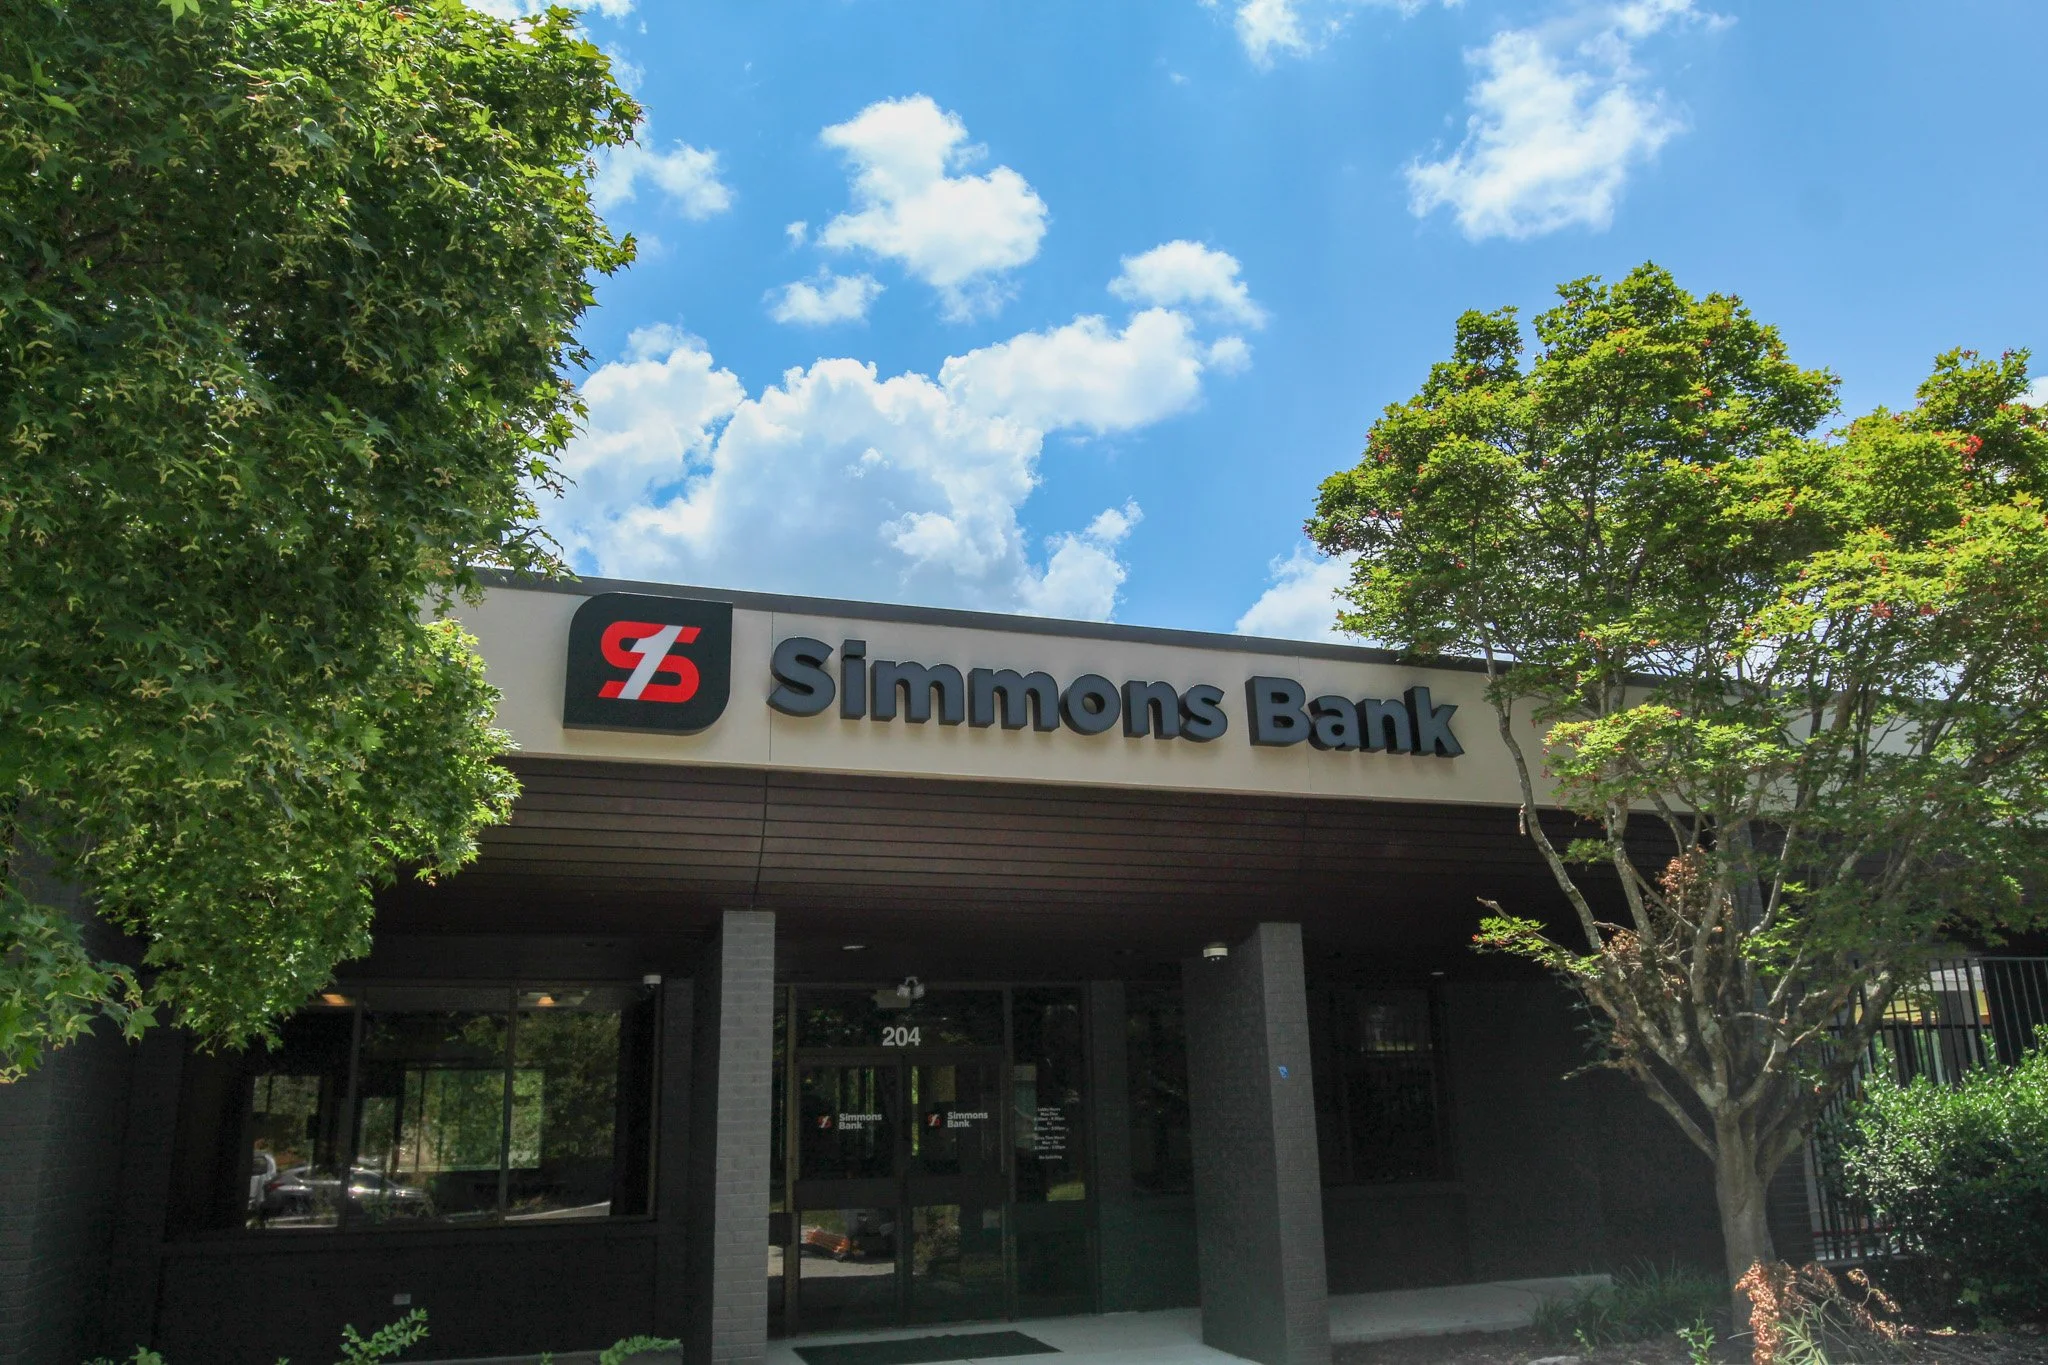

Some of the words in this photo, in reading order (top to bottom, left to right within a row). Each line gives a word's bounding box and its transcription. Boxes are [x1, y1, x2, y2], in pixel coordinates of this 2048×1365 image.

[767, 636, 1228, 743] Simmons
[1245, 675, 1465, 757] Bank
[882, 1027, 921, 1047] 204
[839, 1113, 883, 1122] Simmons
[947, 1111, 988, 1121] Simmons
[838, 1121, 863, 1130] Bank
[947, 1119, 970, 1128] Bank
